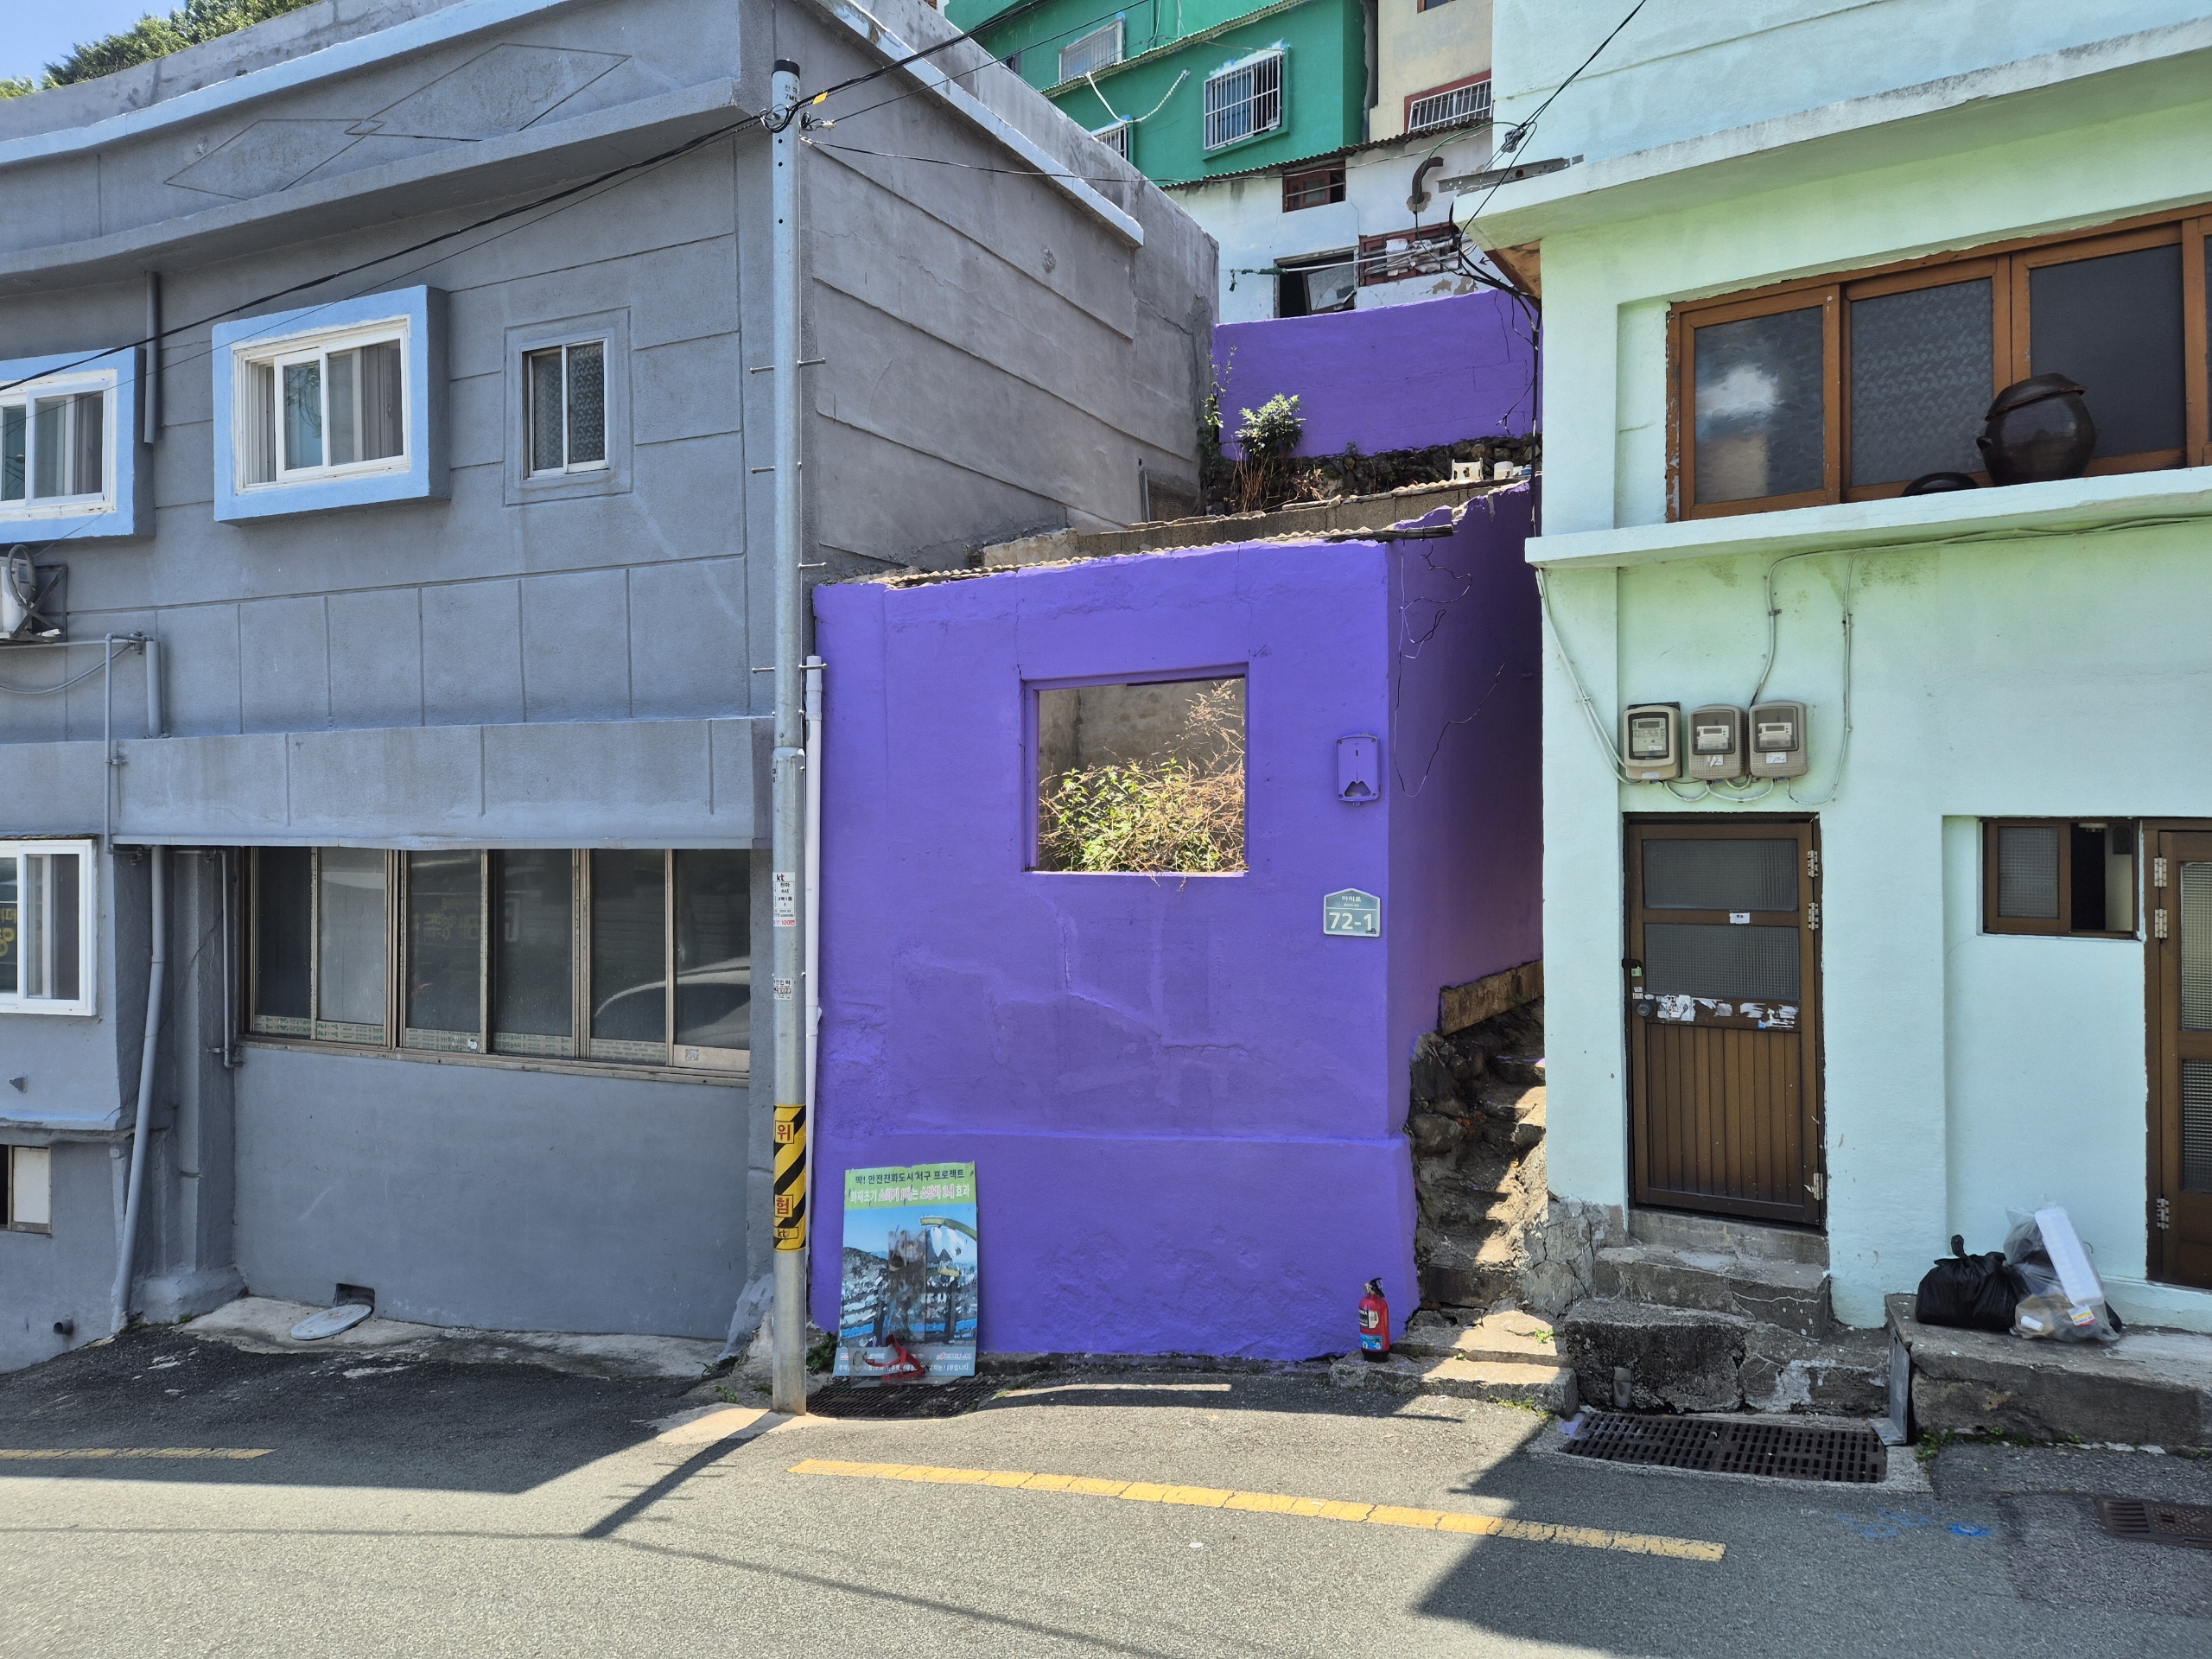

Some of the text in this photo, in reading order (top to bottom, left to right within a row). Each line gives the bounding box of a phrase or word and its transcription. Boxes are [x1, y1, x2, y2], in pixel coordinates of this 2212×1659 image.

[1329, 912, 1372, 931] 72-1
[855, 1175, 866, 1185] 딱!
[933, 1169, 965, 1180] 프로젝트
[849, 1189, 877, 1204] 화재초기
[878, 1187, 899, 1202] 소화기
[919, 1185, 942, 1200] 소방차
[956, 1184, 970, 1198] 효과
[777, 1229, 787, 1238] kt
